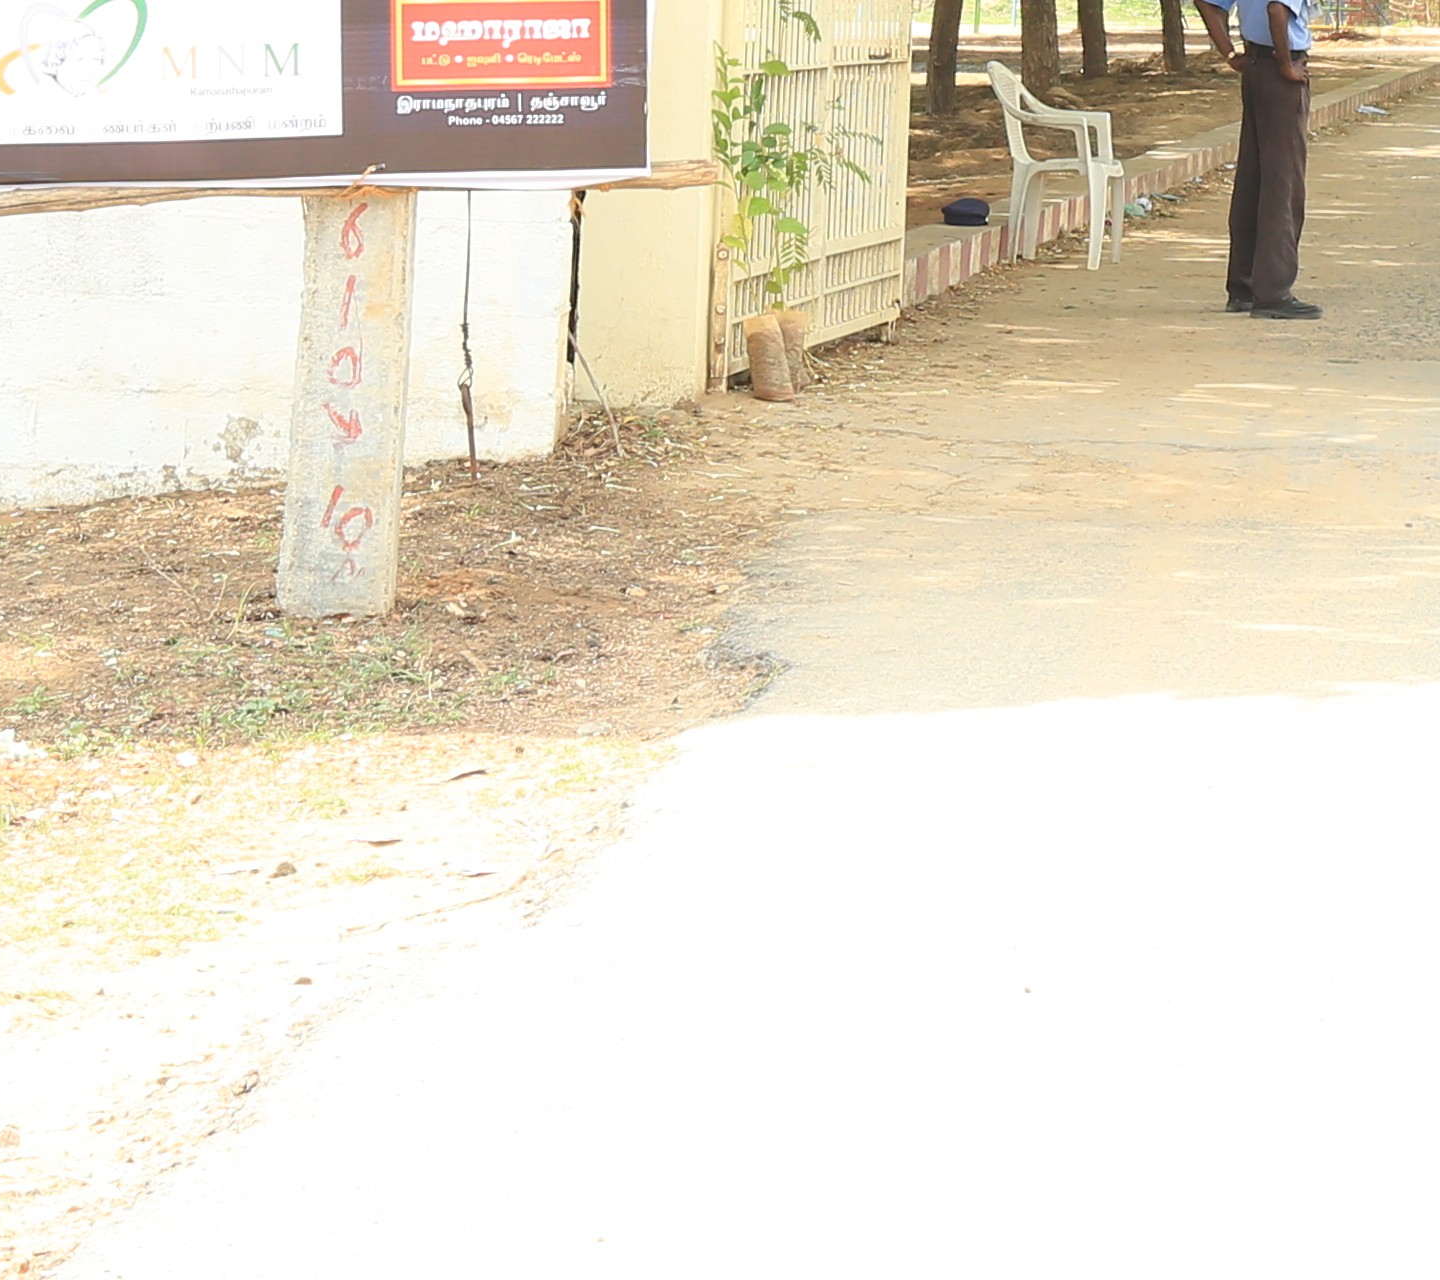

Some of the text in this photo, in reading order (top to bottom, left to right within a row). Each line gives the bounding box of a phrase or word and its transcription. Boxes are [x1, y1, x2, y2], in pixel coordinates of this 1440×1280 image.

[448, 114, 563, 126] Phone 04567 222222
